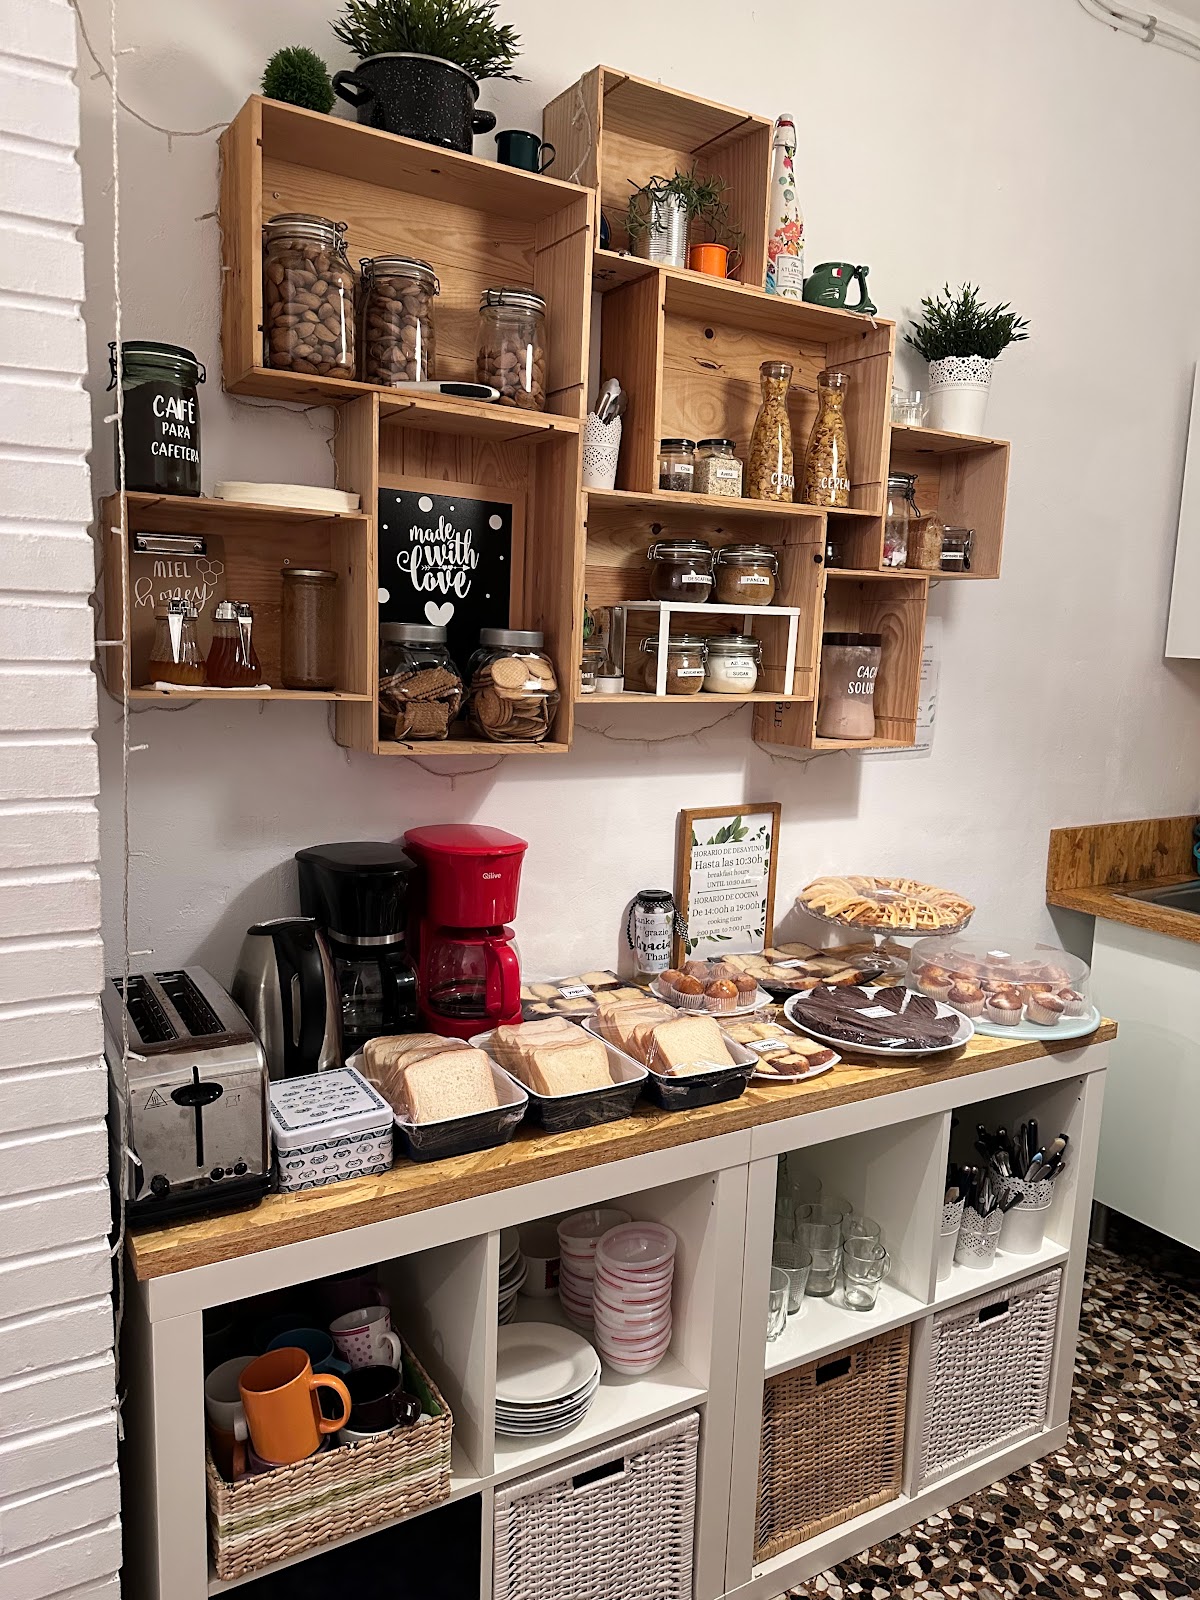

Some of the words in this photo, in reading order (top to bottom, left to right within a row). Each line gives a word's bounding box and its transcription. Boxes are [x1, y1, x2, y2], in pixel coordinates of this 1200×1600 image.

[152, 394, 196, 424] CAFÉ
[162, 421, 191, 440] PARA
[151, 441, 200, 464] CAFETERA
[771, 472, 795, 489] CEREA
[409, 515, 456, 544] made
[424, 528, 480, 570] with
[153, 560, 191, 579] MIEL
[396, 544, 472, 599] love
[693, 849, 723, 858] HORARIO
[732, 845, 765, 854] DESAYUNO
[695, 860, 720, 870] Hasta
[721, 857, 734, 867] las
[735, 854, 763, 866] 10:30h
[707, 870, 733, 879] breakfast
[694, 895, 725, 905] HORARIO
[734, 890, 759, 899] COCINA
[692, 908, 703, 917] De
[704, 904, 729, 915] 14:00h
[735, 901, 760, 911] 19:00h
[637, 917, 655, 925] anke
[644, 929, 669, 938] grazie
